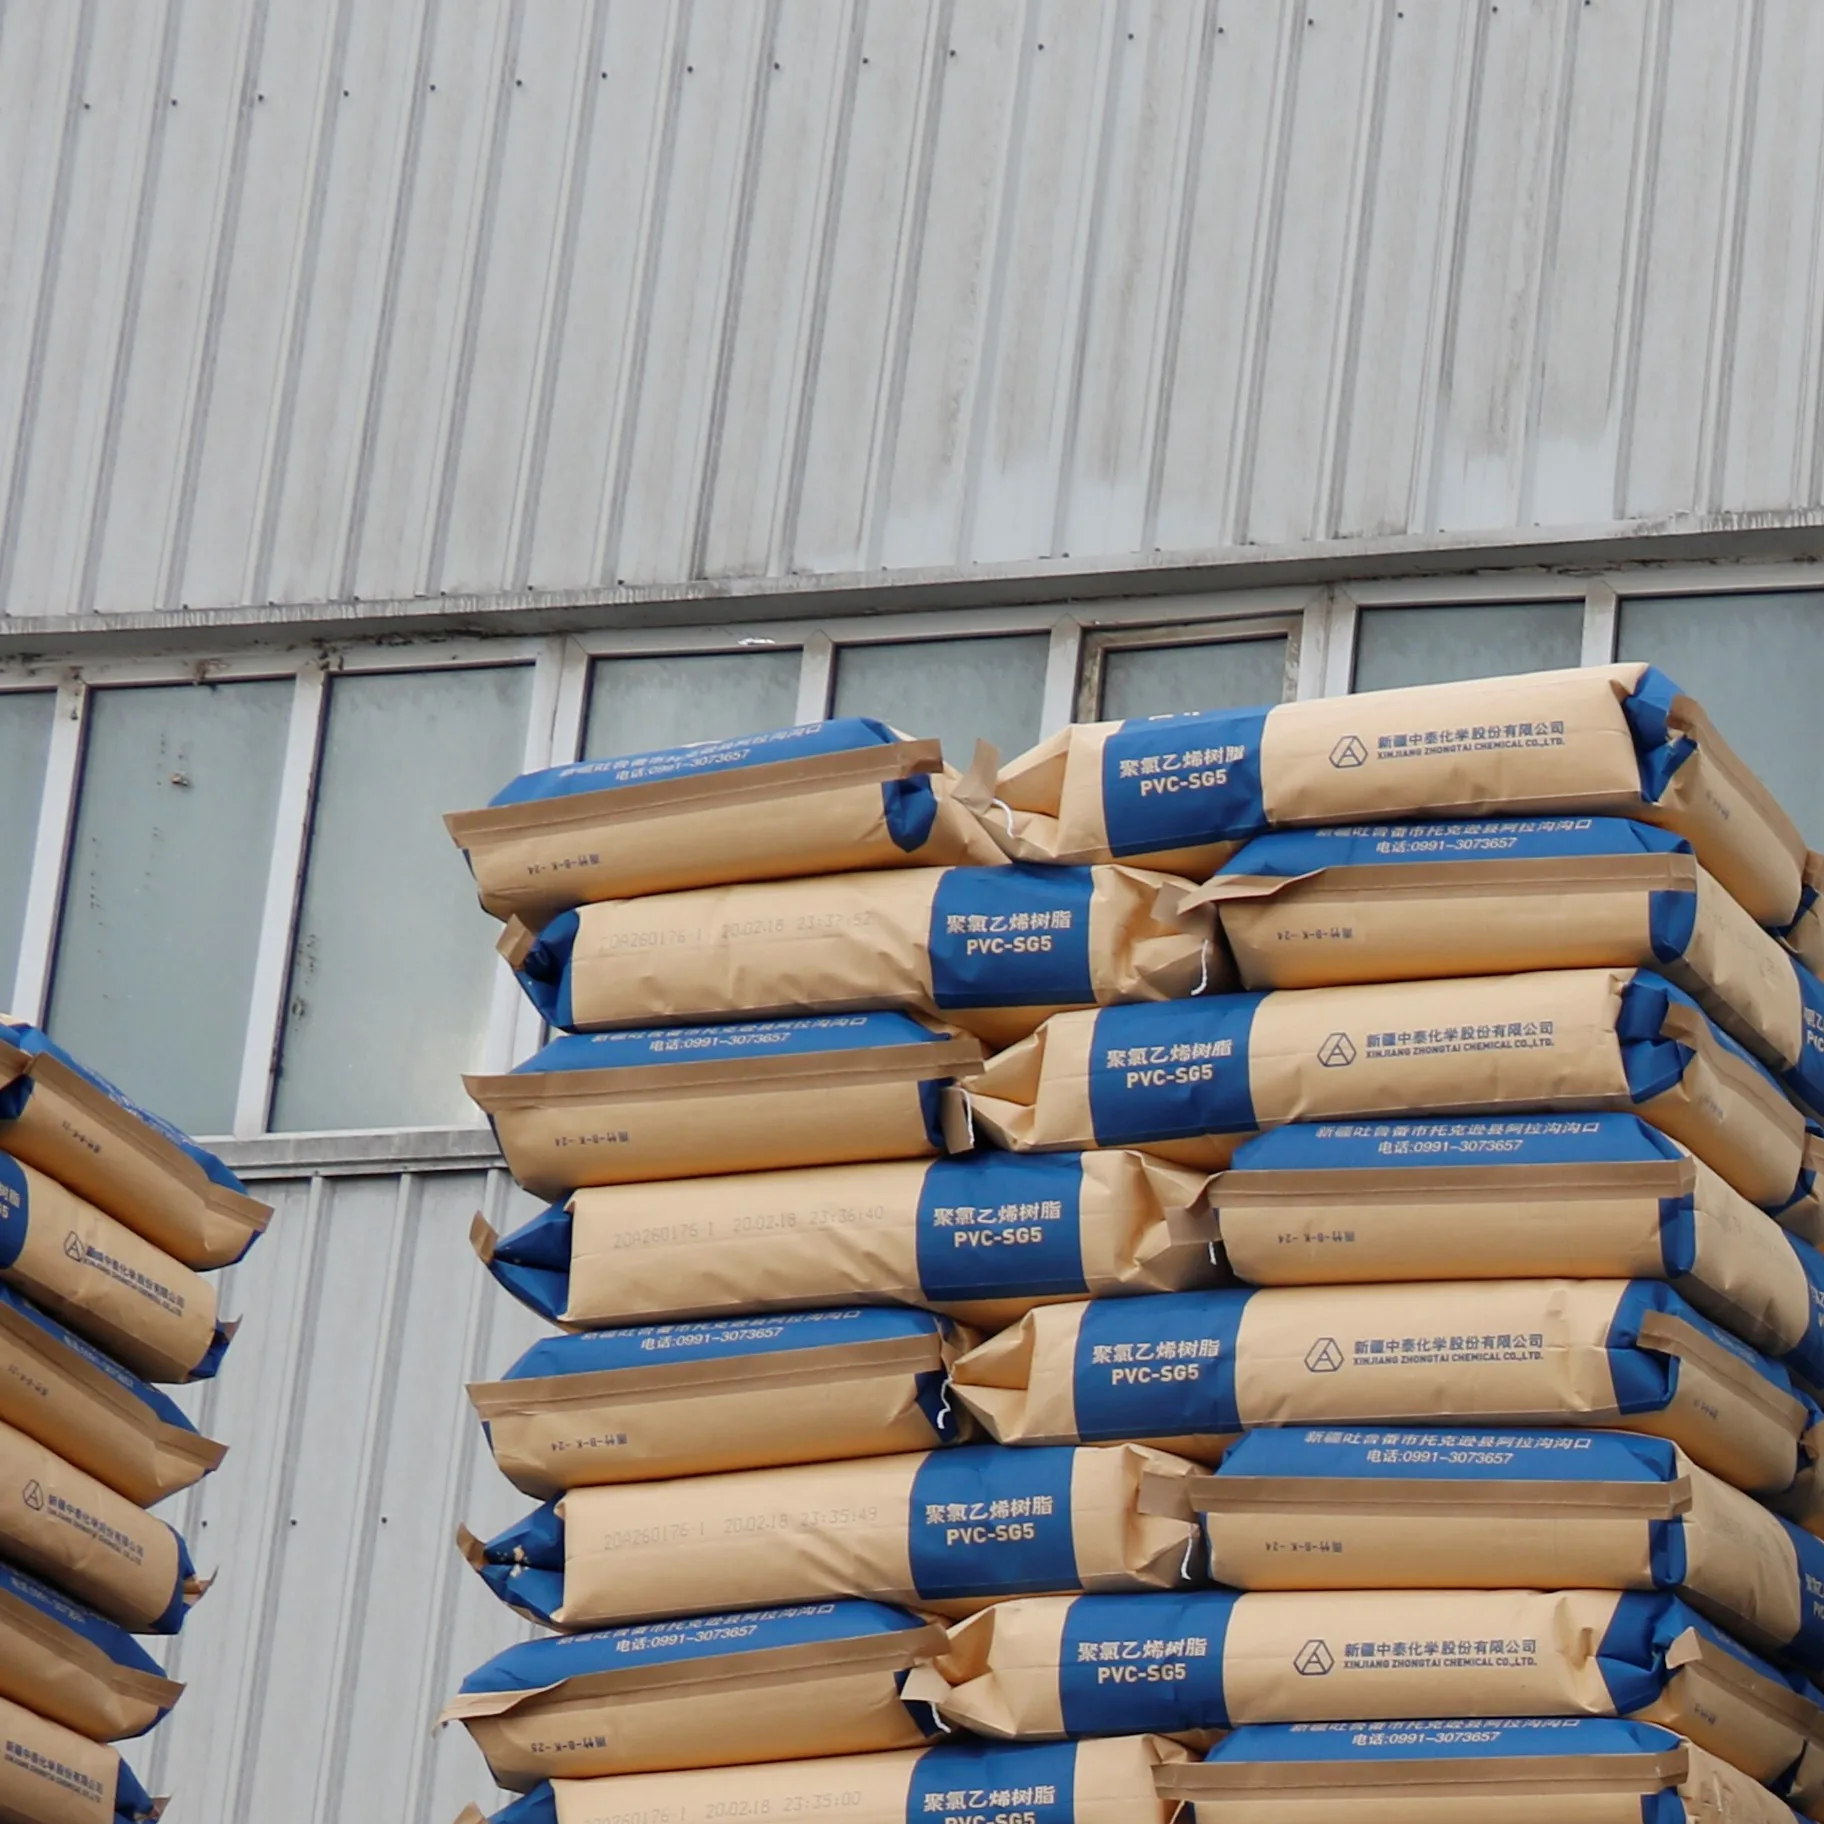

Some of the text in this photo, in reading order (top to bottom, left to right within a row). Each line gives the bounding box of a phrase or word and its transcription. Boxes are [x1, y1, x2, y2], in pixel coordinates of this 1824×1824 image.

[1377, 720, 1564, 748] 新疆中泰化学股份有限公司
[1377, 747, 1422, 759] XINJIANG
[1424, 743, 1472, 755] ZHONGTAI
[1473, 739, 1523, 750] CHEMICAL
[1119, 745, 1245, 777] 聚氯乙烯树脂
[1140, 768, 1226, 795] PVC-SG5
[1376, 836, 1517, 853] 电话:0991-3073657
[946, 910, 1071, 933] 聚氯乙烯树脂
[966, 934, 1052, 954] PVC-SG5
[650, 1032, 789, 1051] 电话:0991-3073657
[1366, 1021, 1553, 1047] 新疆中泰化学股份有限公司
[1106, 1039, 1232, 1067] 聚氯乙烯树脂
[1365, 1047, 1411, 1058] XINJIANG
[1412, 1043, 1461, 1055] ZHONGTAI
[1462, 1040, 1512, 1051] CHEMICAL
[1126, 1063, 1212, 1088] PVC-SG5
[1317, 1122, 1598, 1138] 新疆吐鲁番市托克逊县阿拉沟沟口
[1378, 1139, 1522, 1154] 电话:0991-3073657
[933, 1200, 1061, 1226] 聚氯乙烯树脂
[953, 1226, 1042, 1247] PVC-SG5
[640, 1326, 782, 1350] 电话:0991-3073657
[1354, 1333, 1543, 1354] 新疆中泰化学股份有限公司
[1092, 1338, 1220, 1363] 聚氯乙烯树脂
[1353, 1355, 1398, 1365] XINJIANG
[1400, 1353, 1449, 1364] ZHONGTAI
[1451, 1352, 1501, 1362] CHEMICAL
[1111, 1363, 1199, 1384] PVC-SG5
[1305, 1431, 1590, 1448] 新疆吐鲁番市托克逊县阿拉沟沟口
[1366, 1448, 1513, 1464] 电话:0991-3073657
[925, 1495, 1052, 1523] 聚氯乙烯树脂
[946, 1522, 1034, 1545] PVC-SG5
[616, 1624, 756, 1652] 电话:0991-3073657
[1344, 1639, 1536, 1657] 新疆中泰化学股份有限公司
[1077, 1637, 1207, 1661] 聚氯乙烯树脂
[1097, 1662, 1186, 1683] PVC-SG5
[1343, 1659, 1389, 1669] XINJIANG
[1391, 1658, 1441, 1668] ZHONGTAI
[1442, 1657, 1493, 1667] CHEMICAL
[1352, 1731, 1500, 1746] 电话:0991-3073657
[923, 1785, 1055, 1811] 聚氯乙烯树脂
